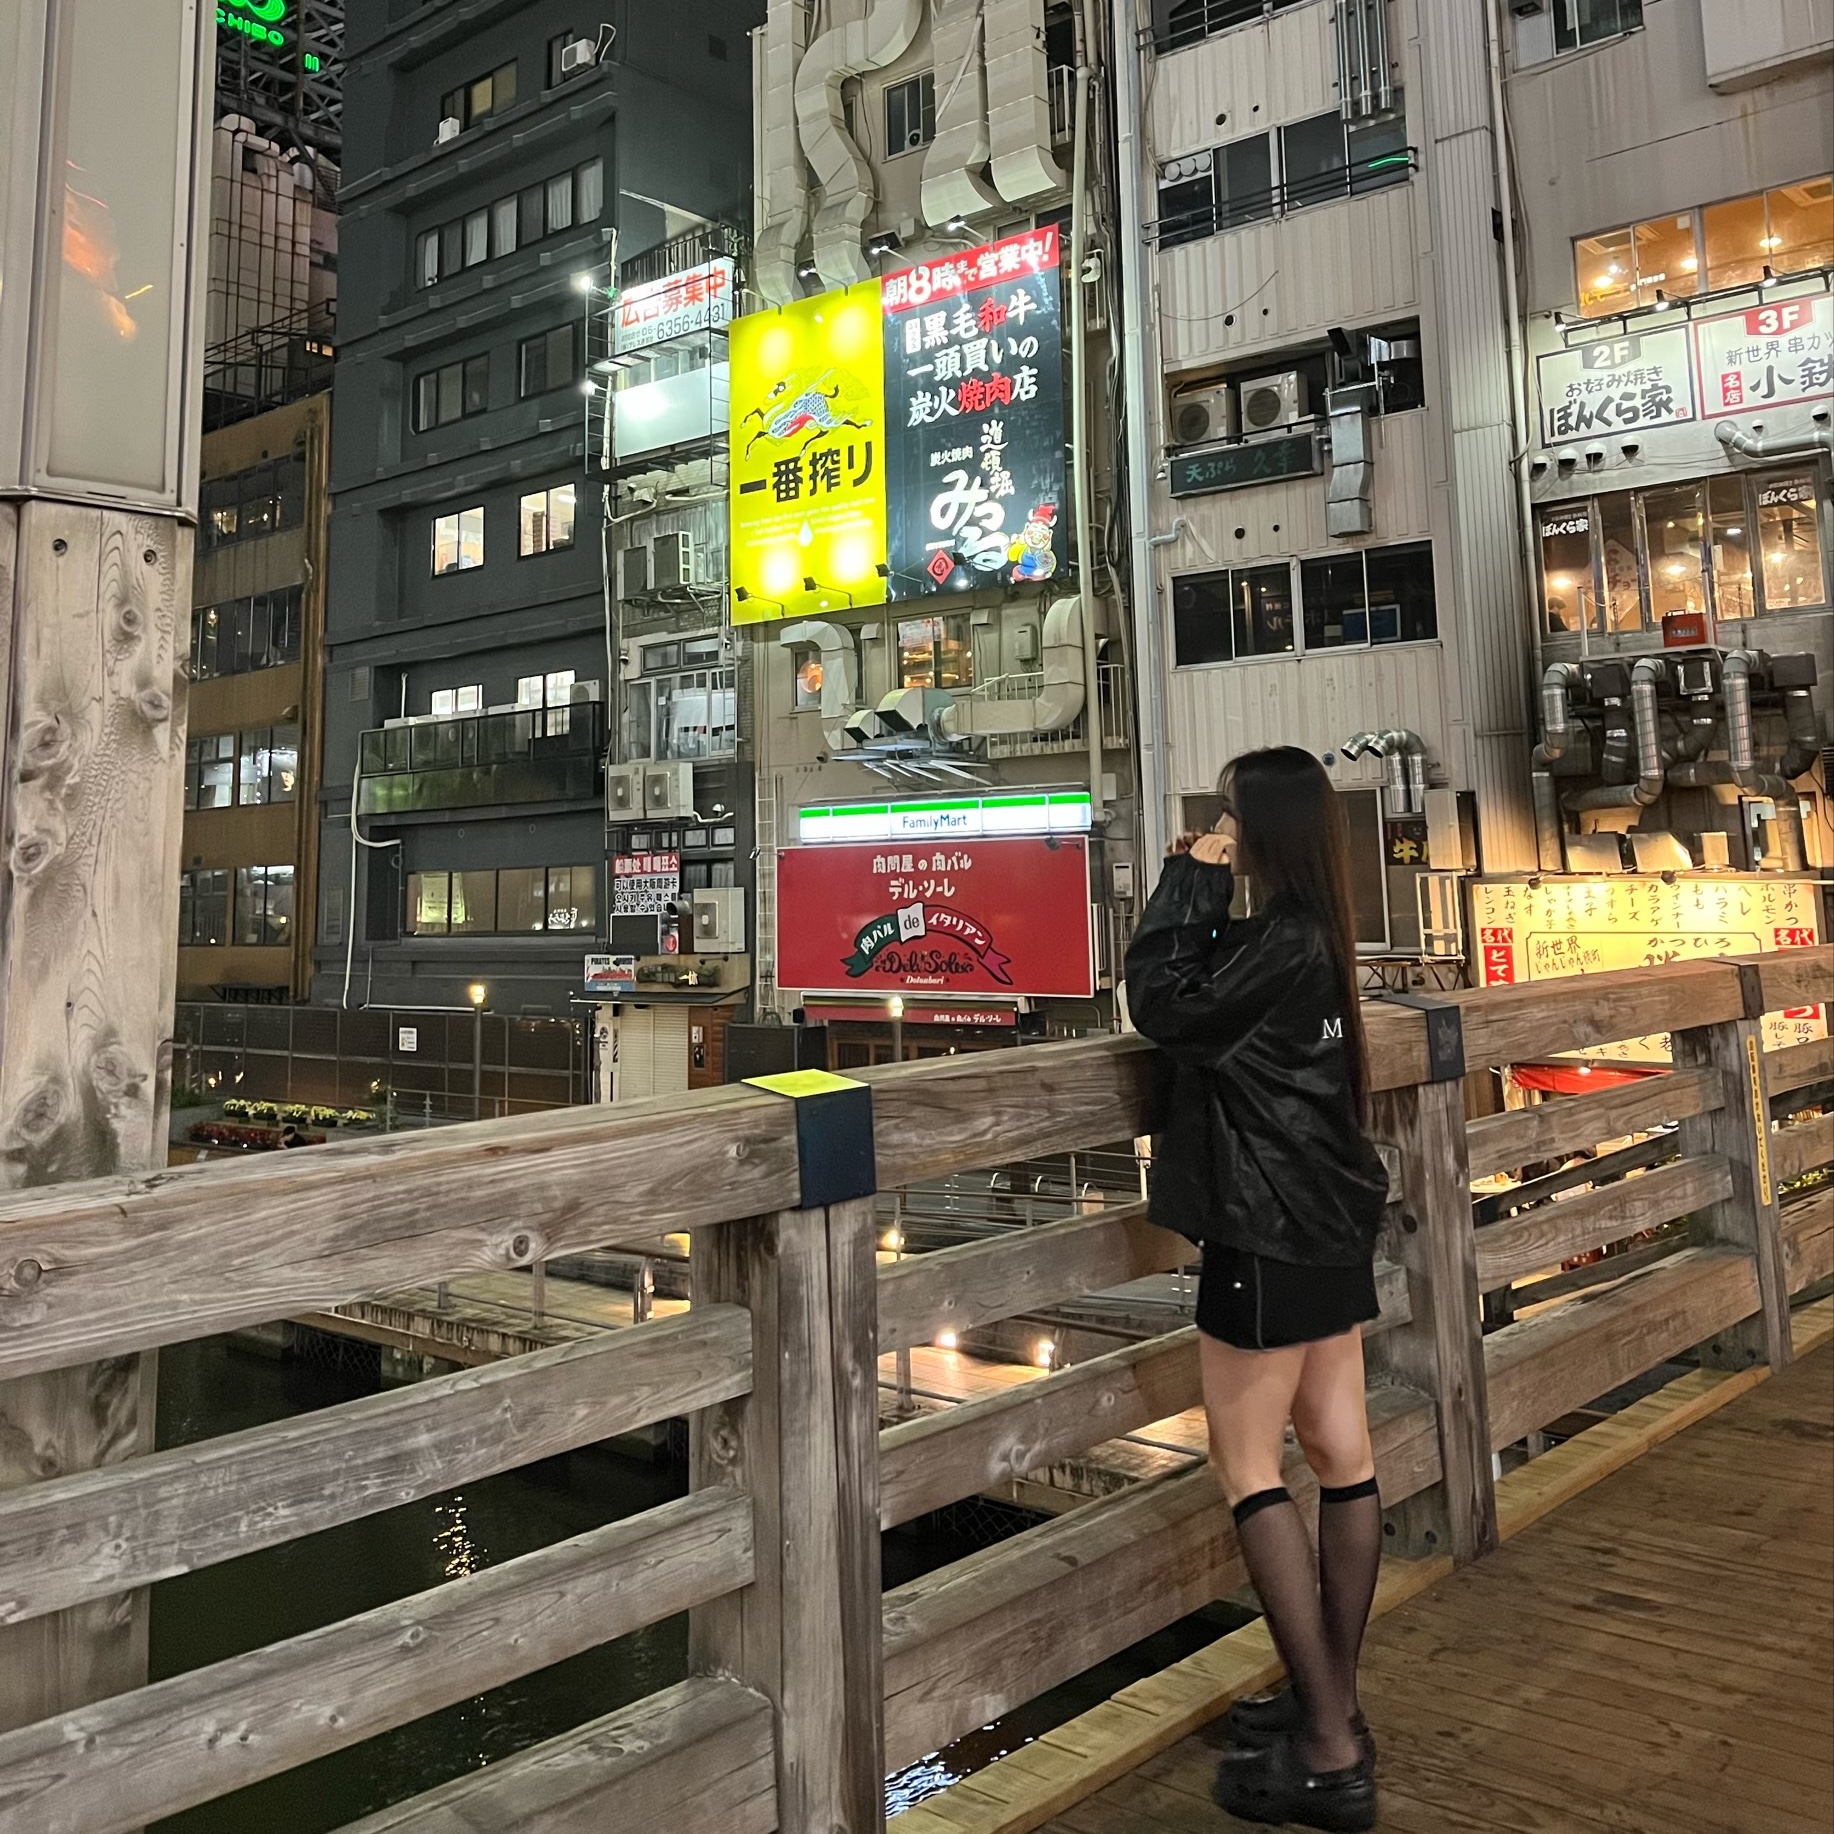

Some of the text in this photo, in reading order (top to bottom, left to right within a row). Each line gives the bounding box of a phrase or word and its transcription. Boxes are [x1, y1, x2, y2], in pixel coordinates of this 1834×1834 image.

[882, 231, 1054, 307] 朝8時まで営業中!
[621, 266, 726, 328] 広告募集中
[922, 288, 1038, 350] 黒毛和牛
[1758, 304, 1800, 334] 3F
[906, 335, 1039, 382] 一頭買いの
[1592, 340, 1631, 369] 2F
[1726, 340, 1782, 366] 新世界
[906, 364, 1039, 428] 炭火焼肉店
[1565, 365, 1663, 397] お好み焼き
[1723, 374, 1742, 404] 名店
[1549, 383, 1674, 438] ぼんくら家
[739, 441, 873, 503] 一番搾り
[930, 445, 974, 467] 炭火焼肉
[979, 419, 1016, 499] 道頓堀
[1186, 457, 1238, 483] 天ぷら
[903, 814, 968, 831] FamilyMart
[889, 877, 956, 900] デル・ソーレ
[1625, 884, 1640, 922] チーズ
[1692, 884, 1705, 910] もも
[1715, 885, 1729, 925] ハラミ
[1760, 883, 1777, 925] ホルモン
[1782, 883, 1800, 926] 串かつ
[860, 912, 986, 955] 肉バル de イタリアン
[1535, 935, 1581, 959] 新世界
[1322, 1017, 1344, 1039] M
